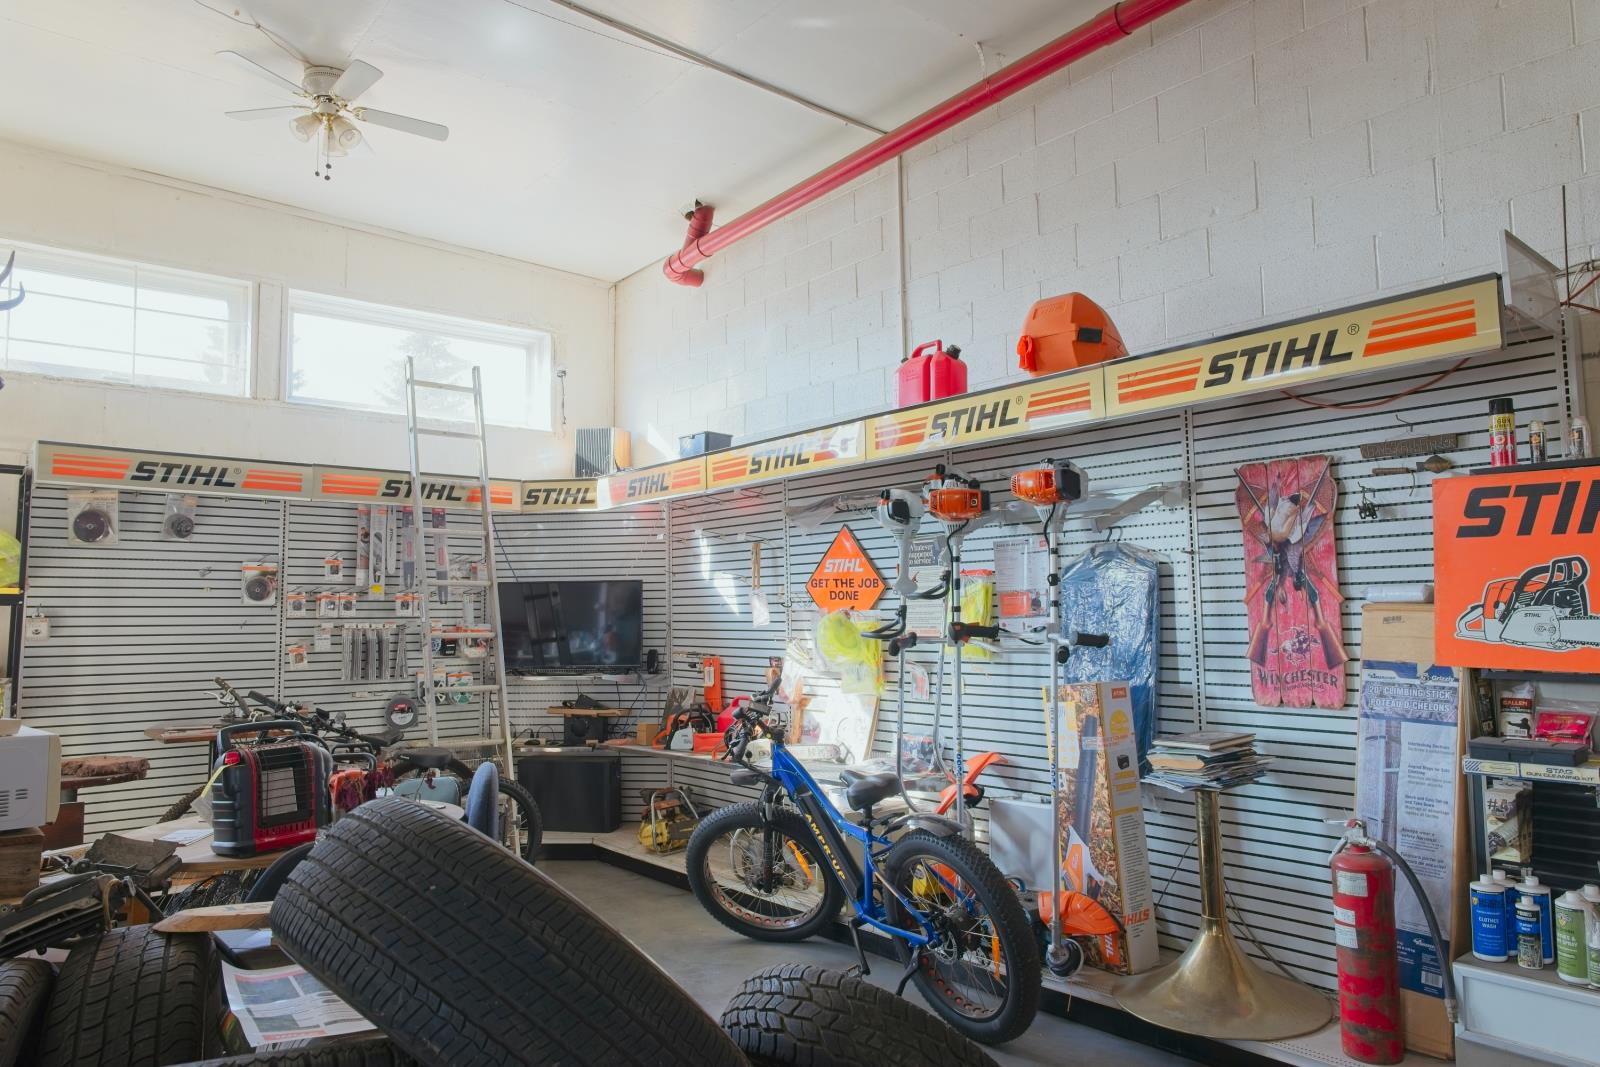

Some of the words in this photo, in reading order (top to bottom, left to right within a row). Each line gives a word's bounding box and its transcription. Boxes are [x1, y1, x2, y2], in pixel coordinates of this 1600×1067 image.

[1203, 329, 1353, 388] STIHL
[929, 399, 1019, 437] STIHL
[749, 443, 810, 475] STIHL
[130, 461, 236, 488] STIHL
[627, 473, 670, 498] STIHL
[523, 487, 596, 506] STIHL
[824, 558, 864, 573] STIHL
[811, 578, 830, 588] GET
[833, 578, 855, 588] THE
[858, 578, 879, 588] JOB
[829, 590, 859, 600] DONE
[1257, 667, 1339, 689] WINCHESTER
[1384, 686, 1424, 698] CLIMBING
[1426, 689, 1451, 700] STICK
